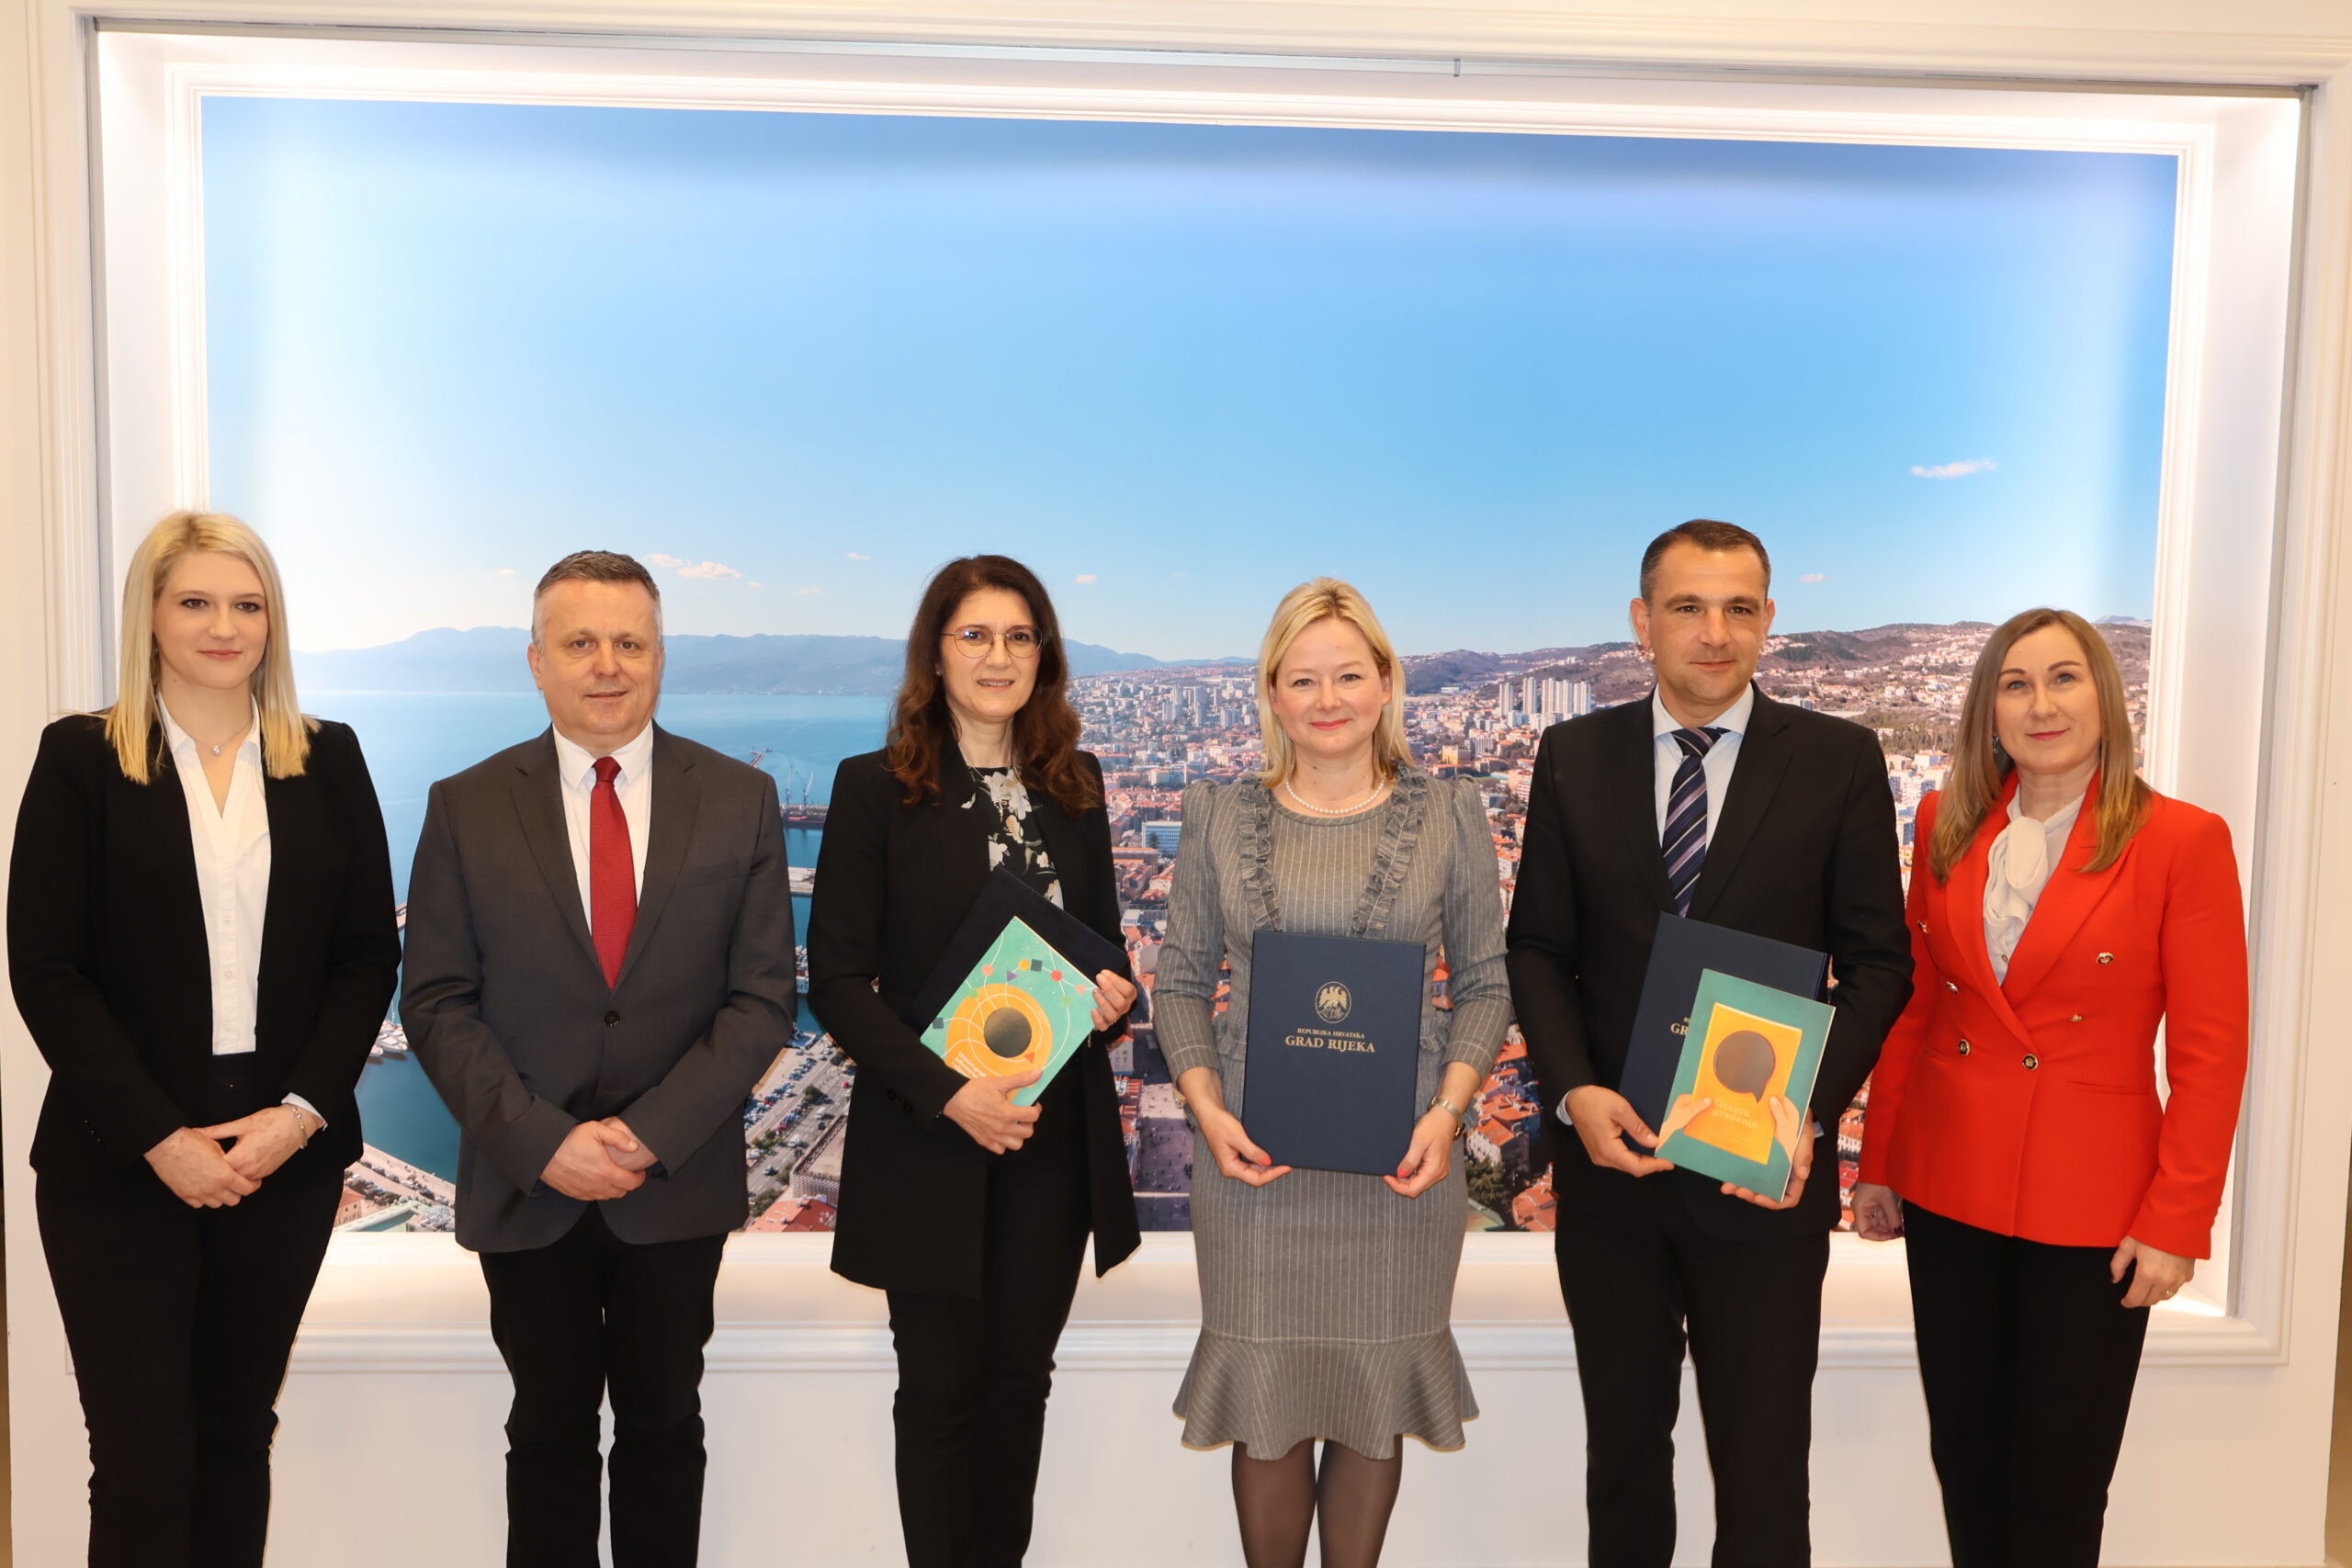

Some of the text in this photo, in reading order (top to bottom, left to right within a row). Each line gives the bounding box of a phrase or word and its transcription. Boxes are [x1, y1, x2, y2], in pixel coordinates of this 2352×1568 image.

[1297, 1028, 1331, 1036] REPUBLIKA
[1670, 1022, 1689, 1035] GR
[1284, 1035, 1375, 1053] GRAD RIJEKA
